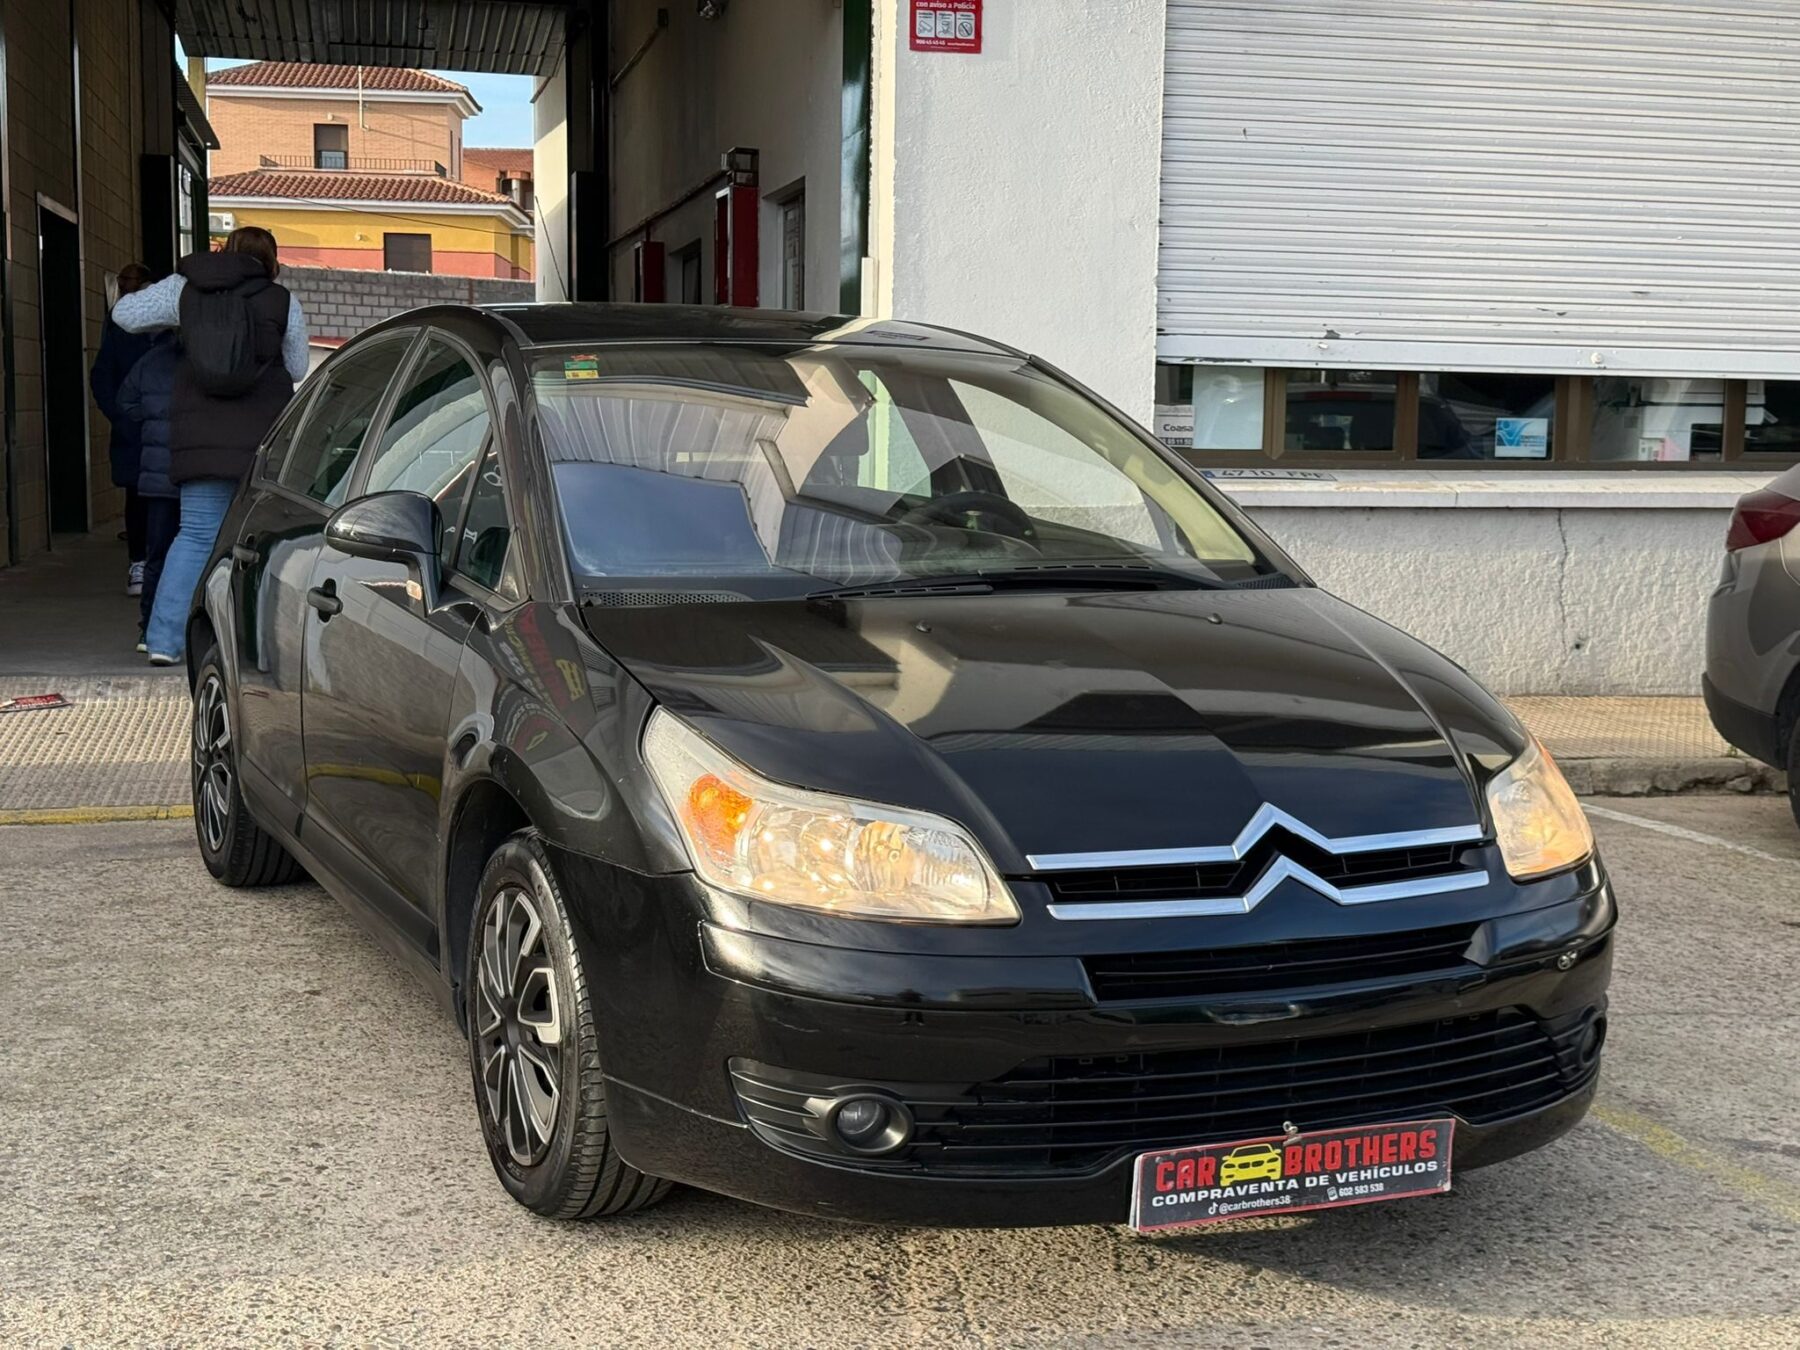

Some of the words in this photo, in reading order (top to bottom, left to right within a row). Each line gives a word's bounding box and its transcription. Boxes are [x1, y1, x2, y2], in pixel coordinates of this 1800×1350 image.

[929, 0, 947, 8] aviso
[1155, 1156, 1216, 1192] CAR
[1284, 1129, 1437, 1176] BROTHERS
[1152, 1178, 1299, 1207] COMPRAVENTA
[1305, 1174, 1330, 1188] DE
[1335, 1160, 1438, 1184] VEHÍCULOS
[1218, 1195, 1291, 1215] @carbrothers38
[1338, 1186, 1354, 1197] 602
